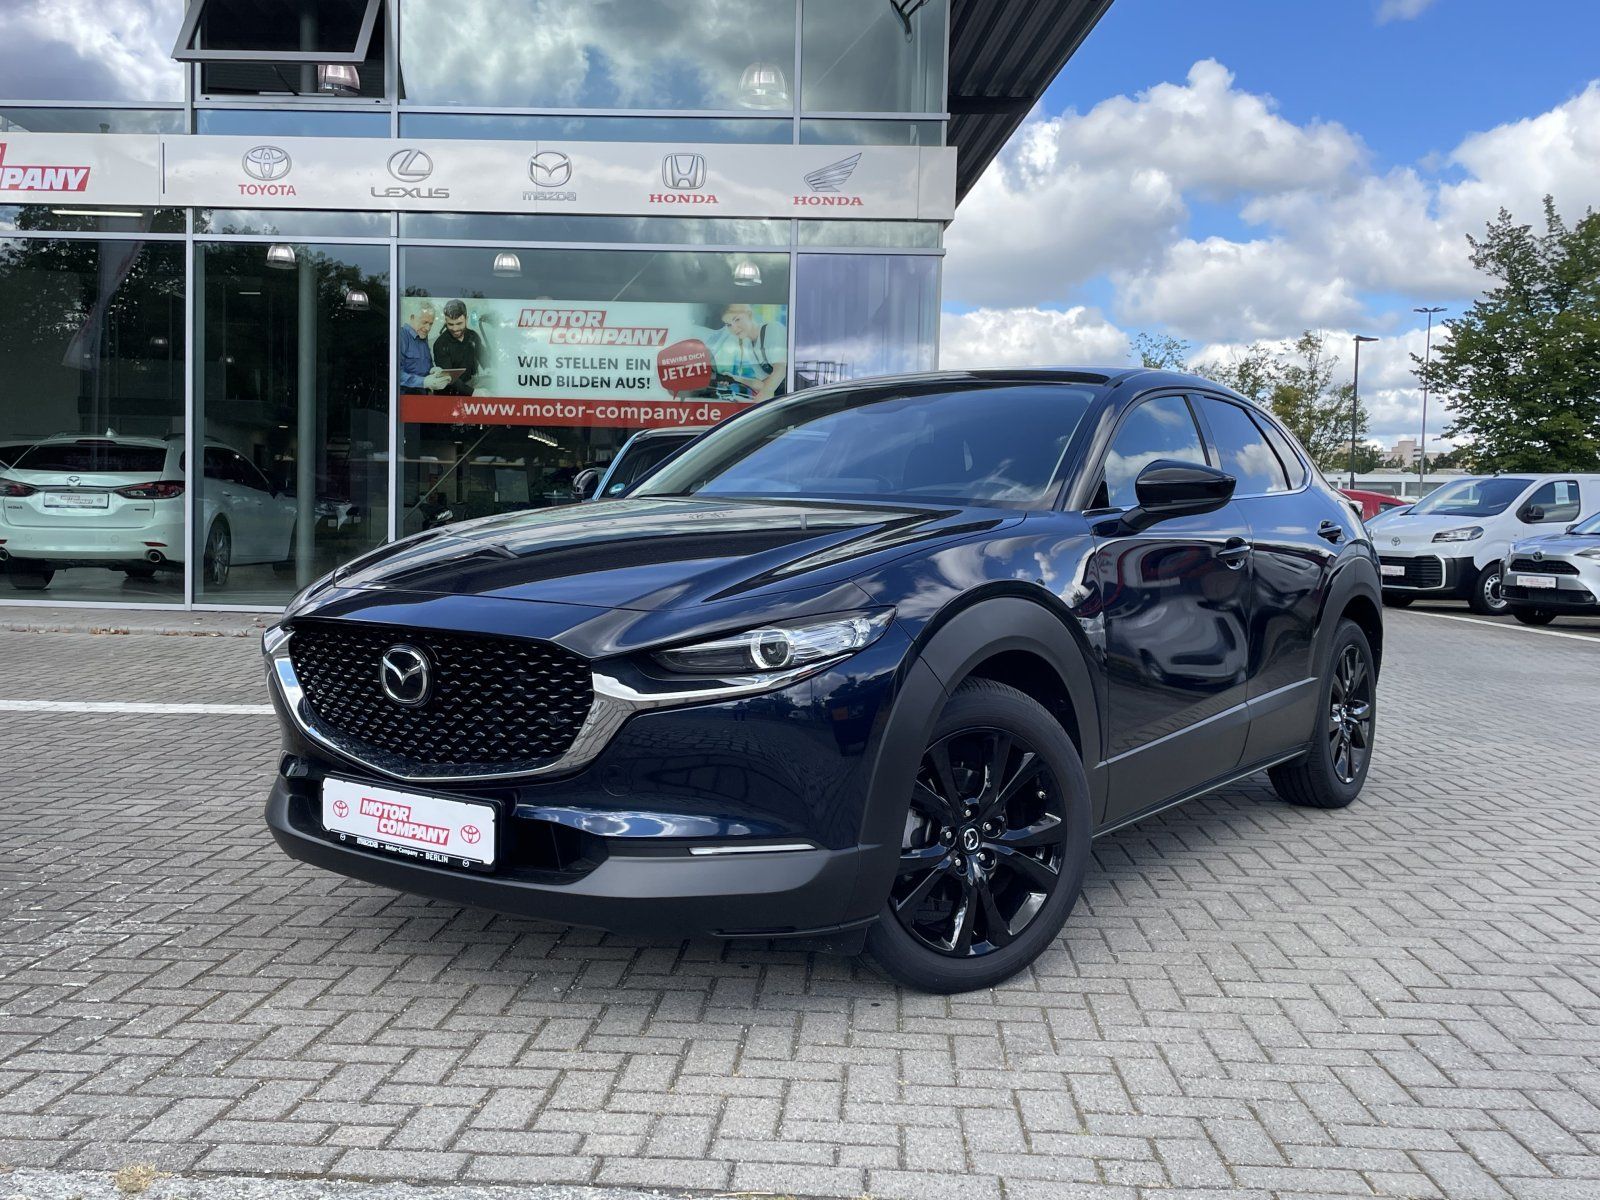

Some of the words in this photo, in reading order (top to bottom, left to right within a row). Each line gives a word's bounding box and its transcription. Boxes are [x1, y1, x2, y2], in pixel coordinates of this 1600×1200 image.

[0, 167, 88, 190] PANY
[238, 184, 296, 196] TOYOTA
[370, 186, 450, 199] LEXUS
[649, 193, 719, 204] HONDA
[793, 195, 864, 206] HONDA
[519, 309, 604, 327] MOTOR
[550, 328, 667, 345] COMPANY
[517, 355, 548, 369] WIR
[555, 357, 618, 370] STELLEN
[625, 358, 651, 371] EIN
[661, 355, 688, 366] BEWIRB
[688, 352, 706, 361] DICH
[661, 361, 708, 382] JETZT!
[517, 374, 552, 387] UND
[556, 375, 611, 388] BILDEN
[614, 377, 651, 390] AUS!
[464, 402, 722, 422] www.motor-company.de
[361, 799, 410, 822] MOTOR
[379, 818, 449, 844] COMPANY
[425, 852, 449, 864] BERLIN
